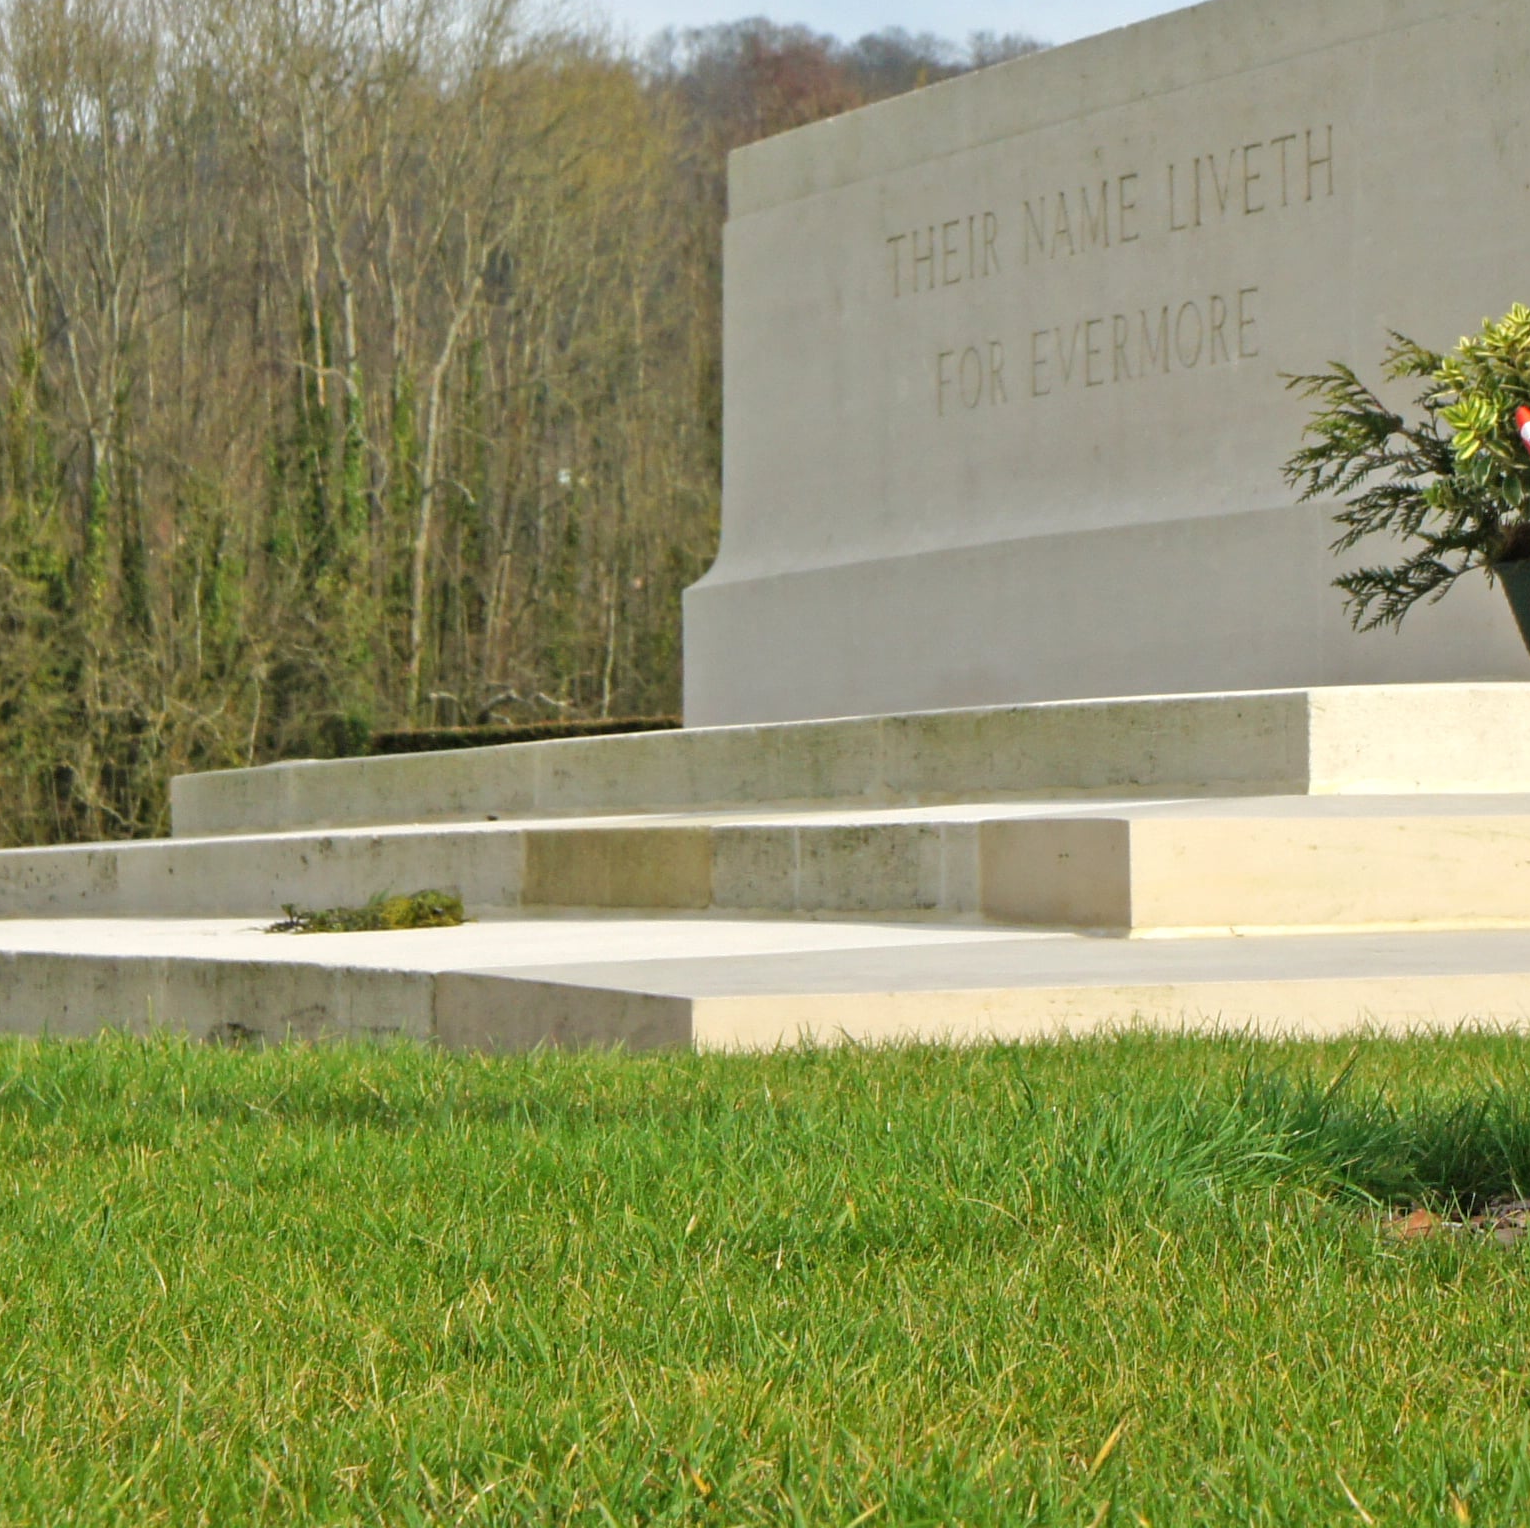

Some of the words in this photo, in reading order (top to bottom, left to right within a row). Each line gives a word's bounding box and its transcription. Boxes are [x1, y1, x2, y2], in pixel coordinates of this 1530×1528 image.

[886, 211, 1000, 298] THEIR
[1023, 173, 1139, 265] NAME
[1169, 124, 1335, 233] LIVETH
[936, 340, 1008, 417] FOR
[1030, 286, 1259, 397] EVERMORE
